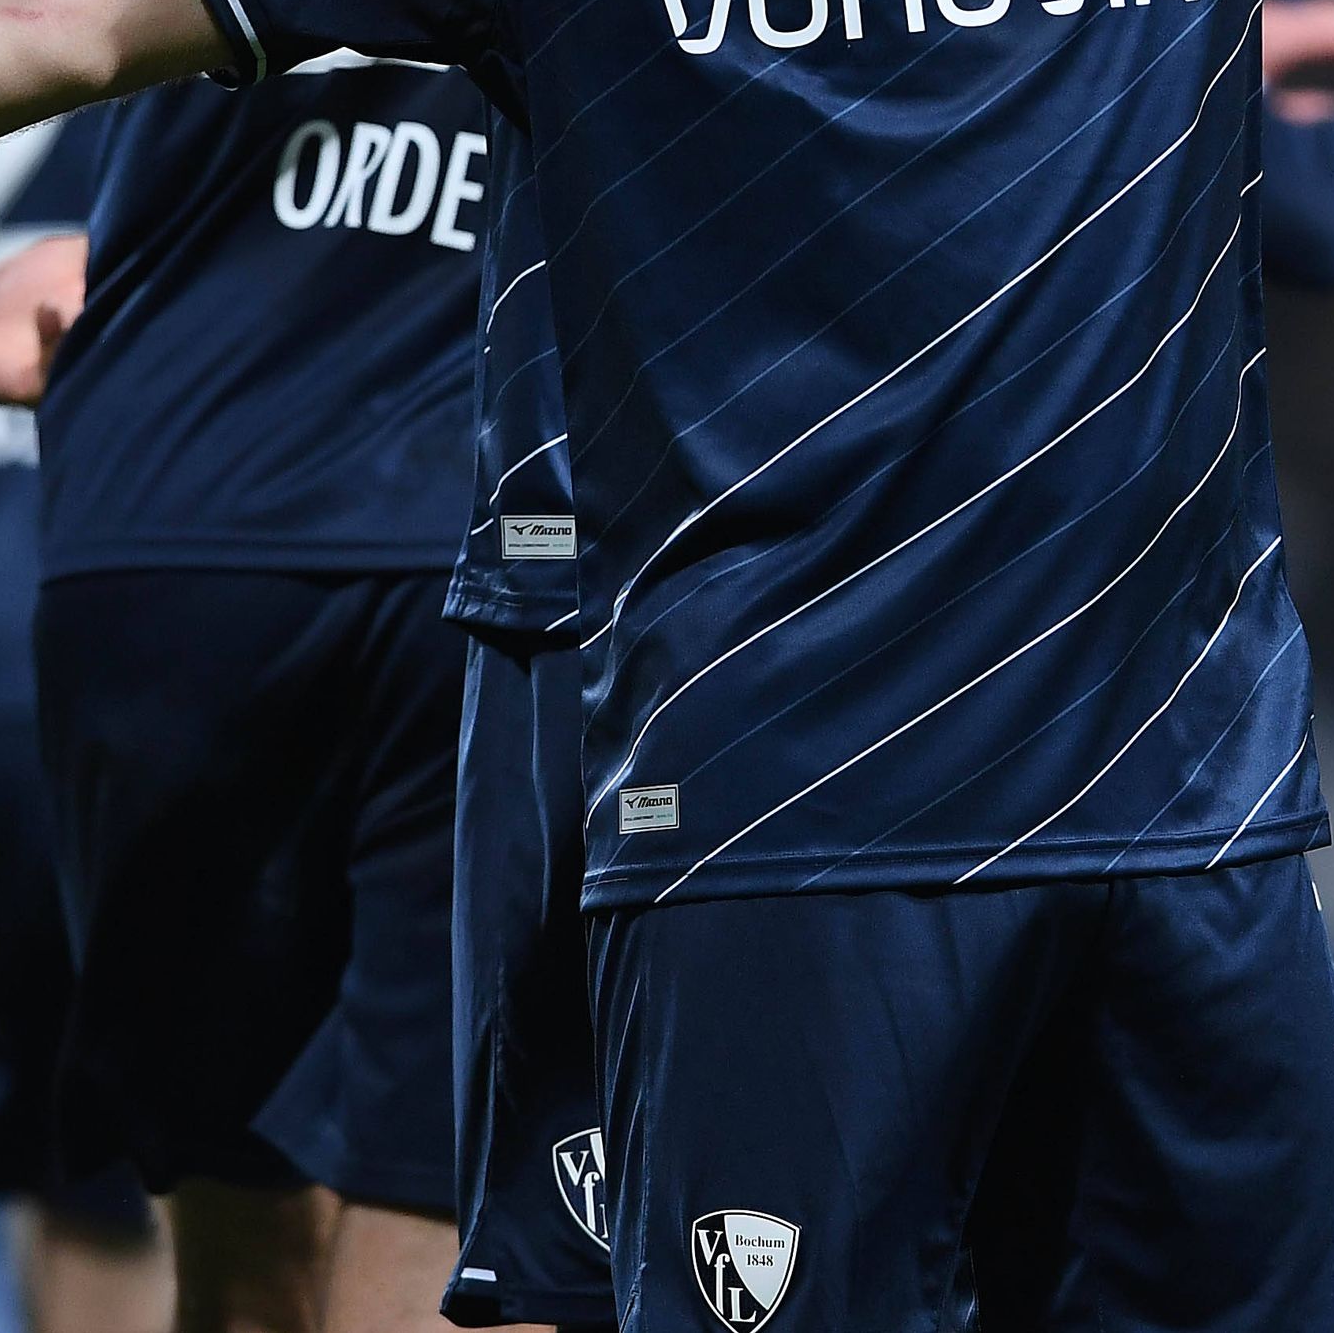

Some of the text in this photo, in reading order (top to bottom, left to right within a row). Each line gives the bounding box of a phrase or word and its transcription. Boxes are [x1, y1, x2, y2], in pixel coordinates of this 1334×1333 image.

[735, 1234, 785, 1249] Bochum
[746, 1254, 774, 1267] 1848
[696, 1229, 758, 1323] VfL
